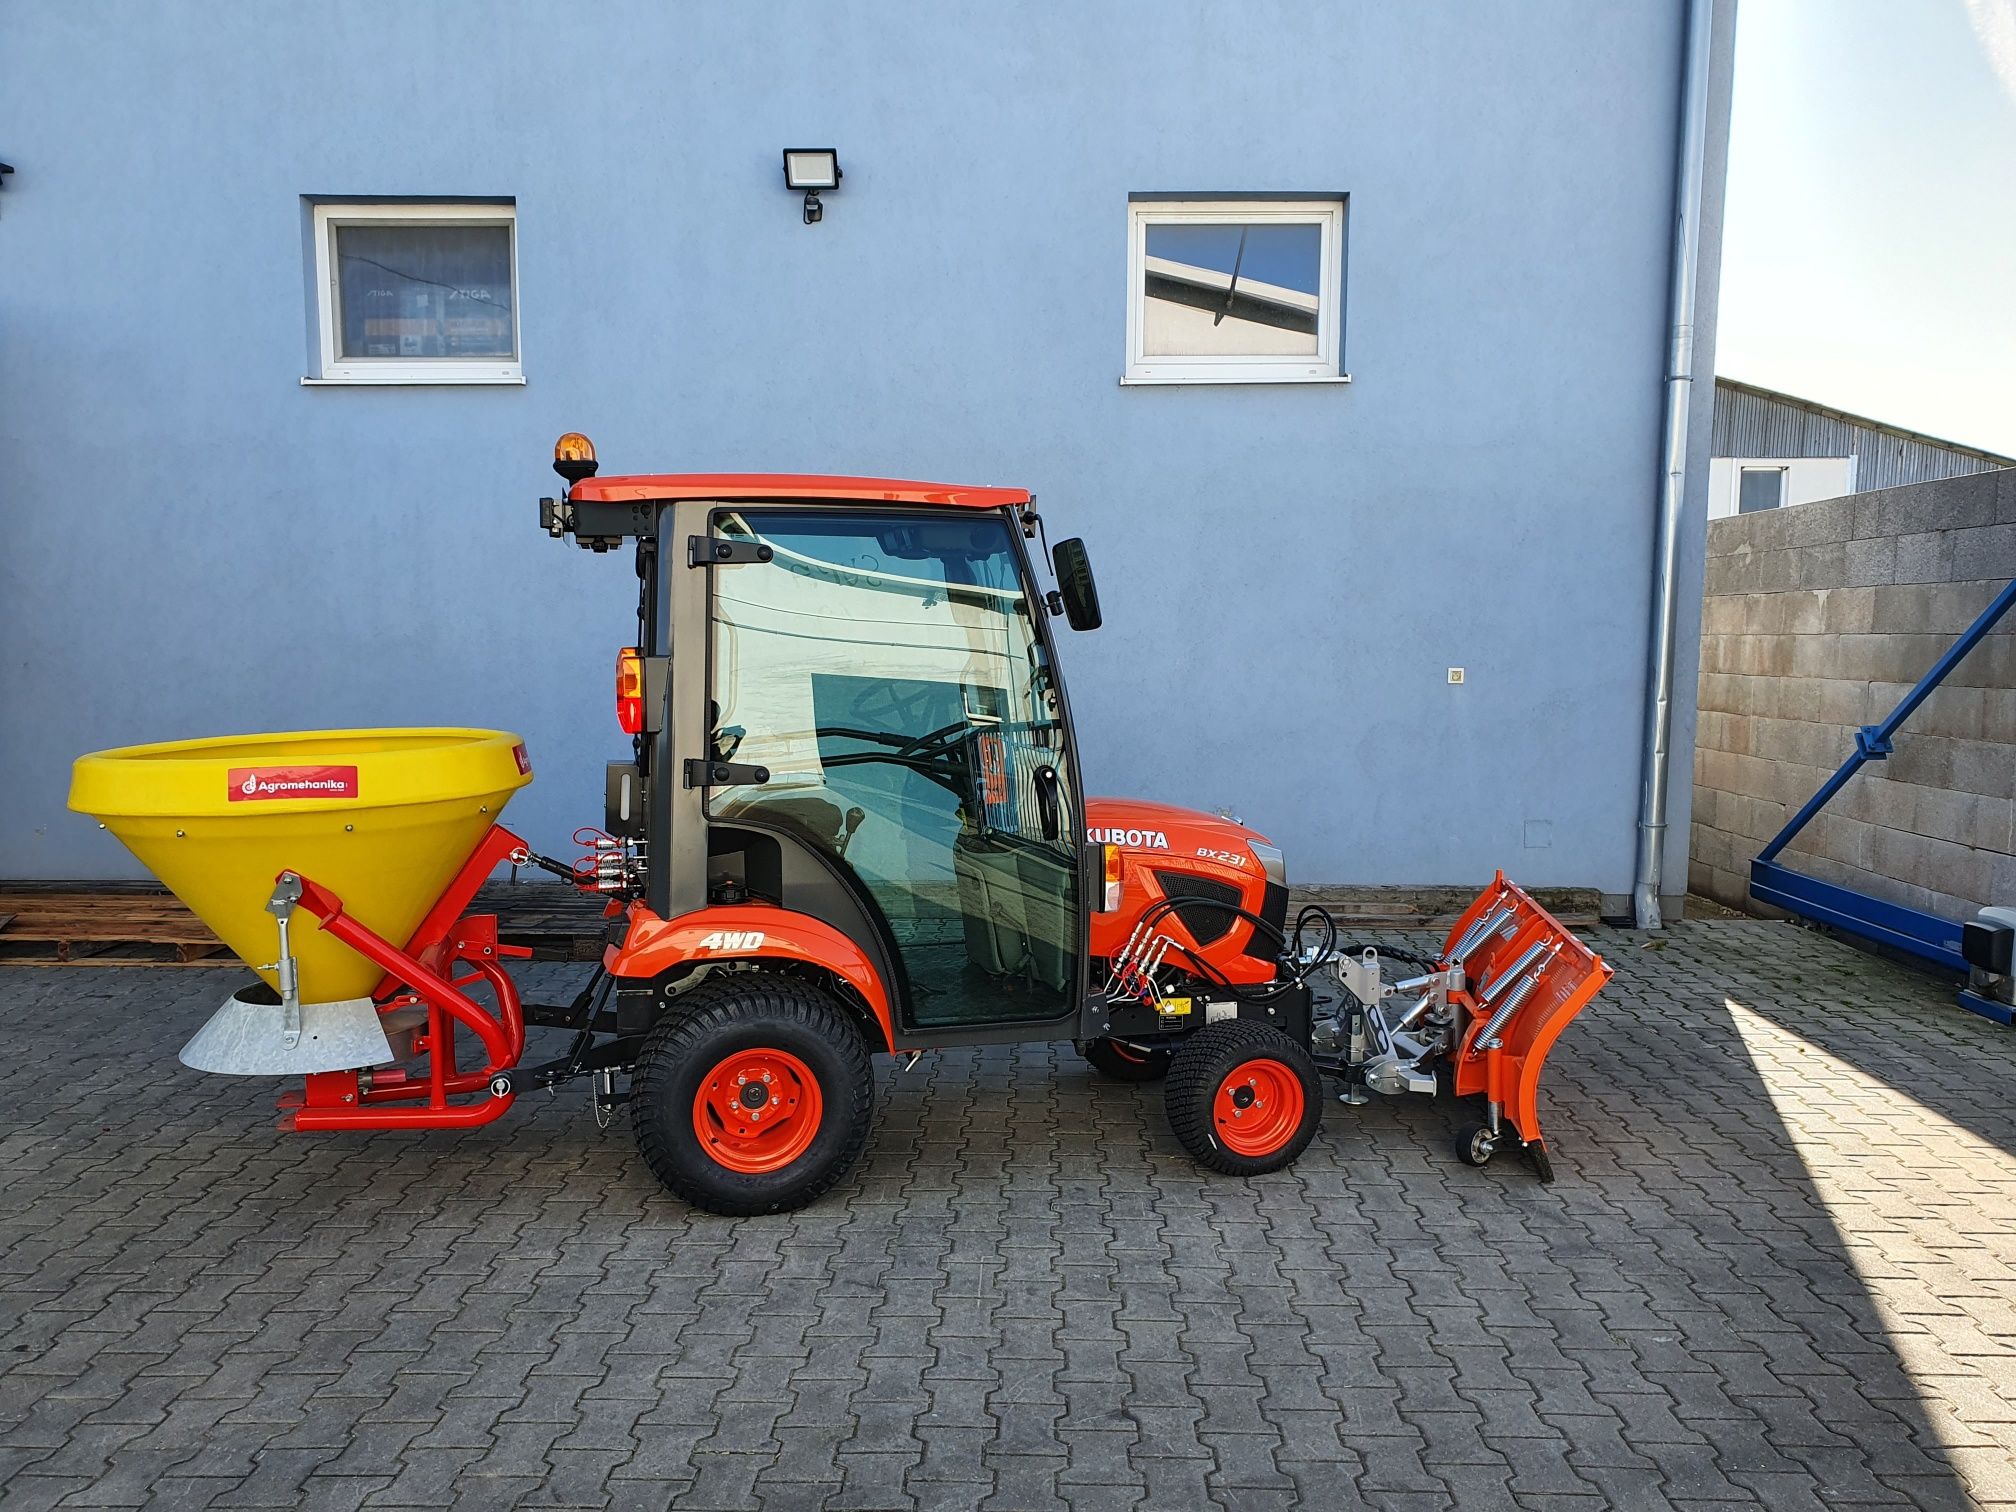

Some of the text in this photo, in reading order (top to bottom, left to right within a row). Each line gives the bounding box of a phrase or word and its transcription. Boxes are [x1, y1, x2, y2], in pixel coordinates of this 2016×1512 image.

[258, 780, 345, 794] Agromehanika
[1197, 847, 1246, 867] BX231
[699, 931, 765, 950] 4WD
